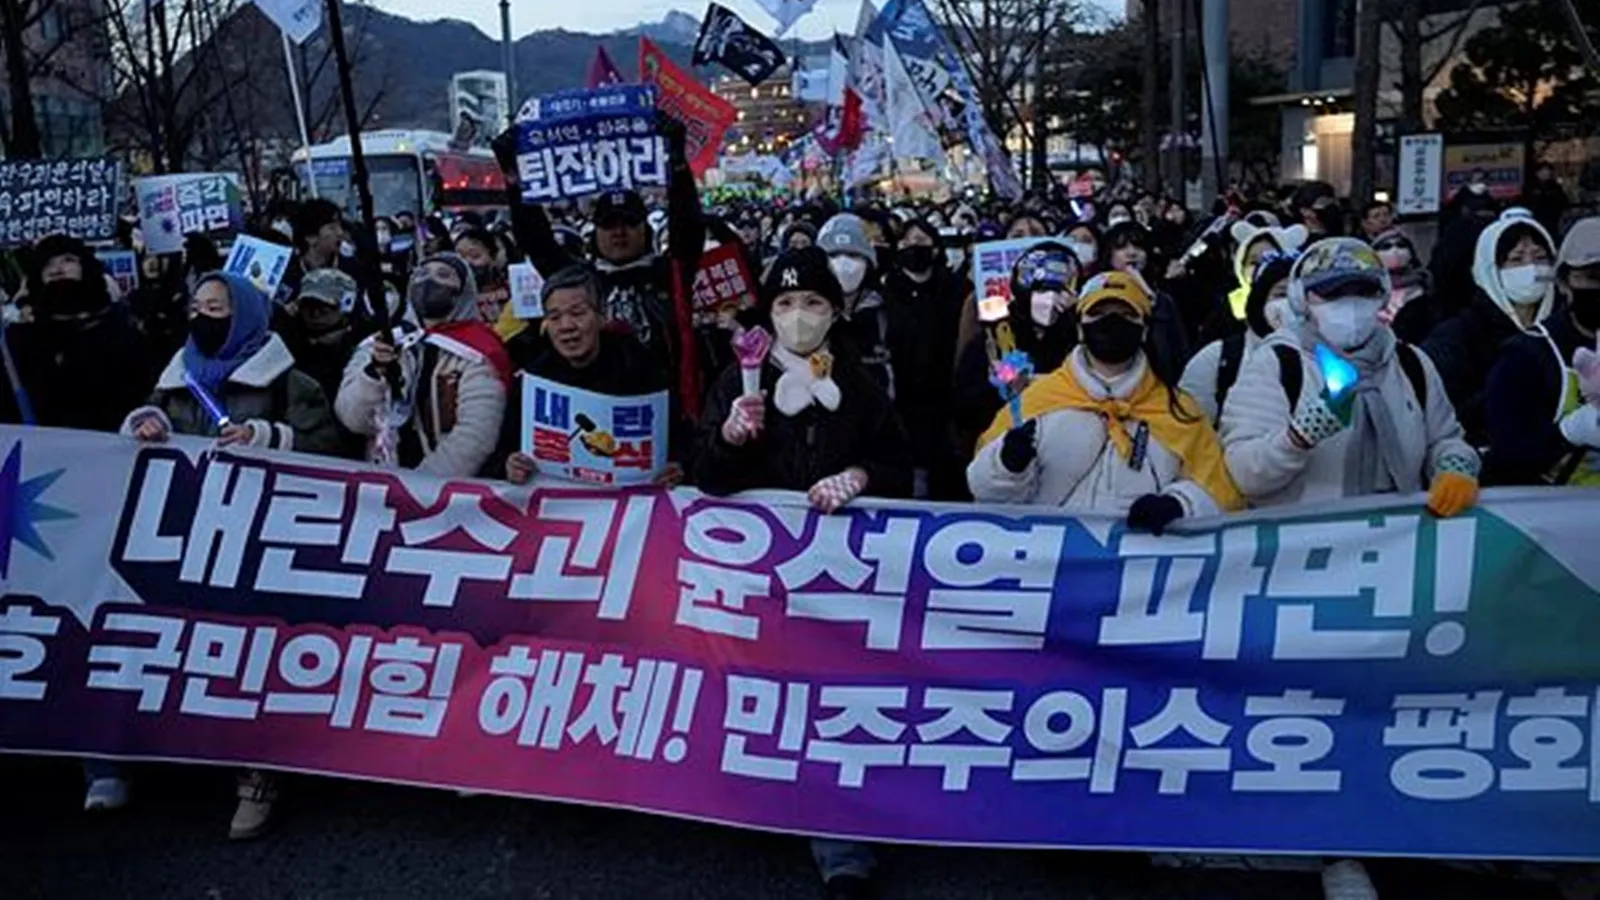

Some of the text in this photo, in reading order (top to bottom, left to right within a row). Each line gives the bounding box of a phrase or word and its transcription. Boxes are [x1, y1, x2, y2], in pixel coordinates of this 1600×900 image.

[181, 203, 230, 233] 파면
[516, 135, 669, 198] 퇴진하라
[123, 458, 1478, 659] 내란수괴 윤석열 파면!
[87, 612, 464, 738] 국민의힘
[479, 646, 703, 763] 해체!
[721, 673, 1345, 794] 민주주의수호
